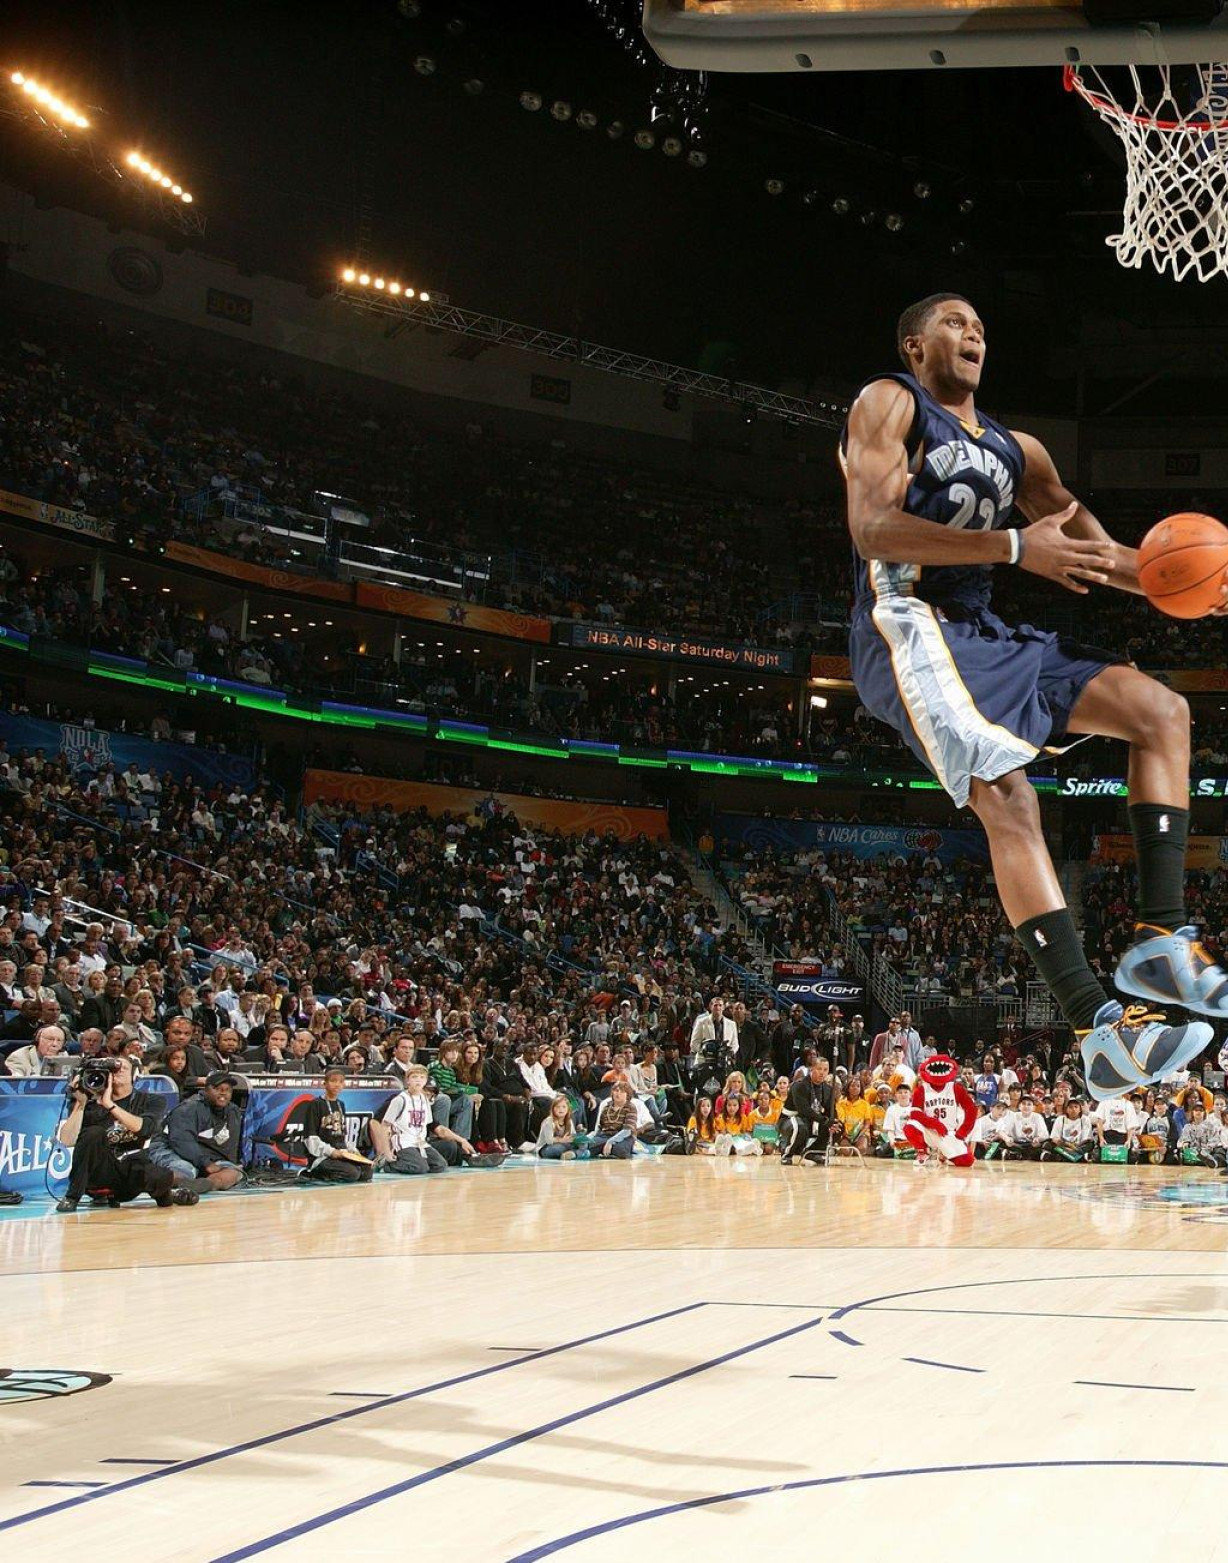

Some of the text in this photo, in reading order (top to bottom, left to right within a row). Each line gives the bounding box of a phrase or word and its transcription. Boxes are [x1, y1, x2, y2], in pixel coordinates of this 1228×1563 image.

[588, 630, 780, 667] NBA All-Star Saturday Night
[1061, 778, 1121, 797] Sprite
[828, 826, 899, 845] NBA Cares
[777, 983, 863, 995] BUD LIGHT
